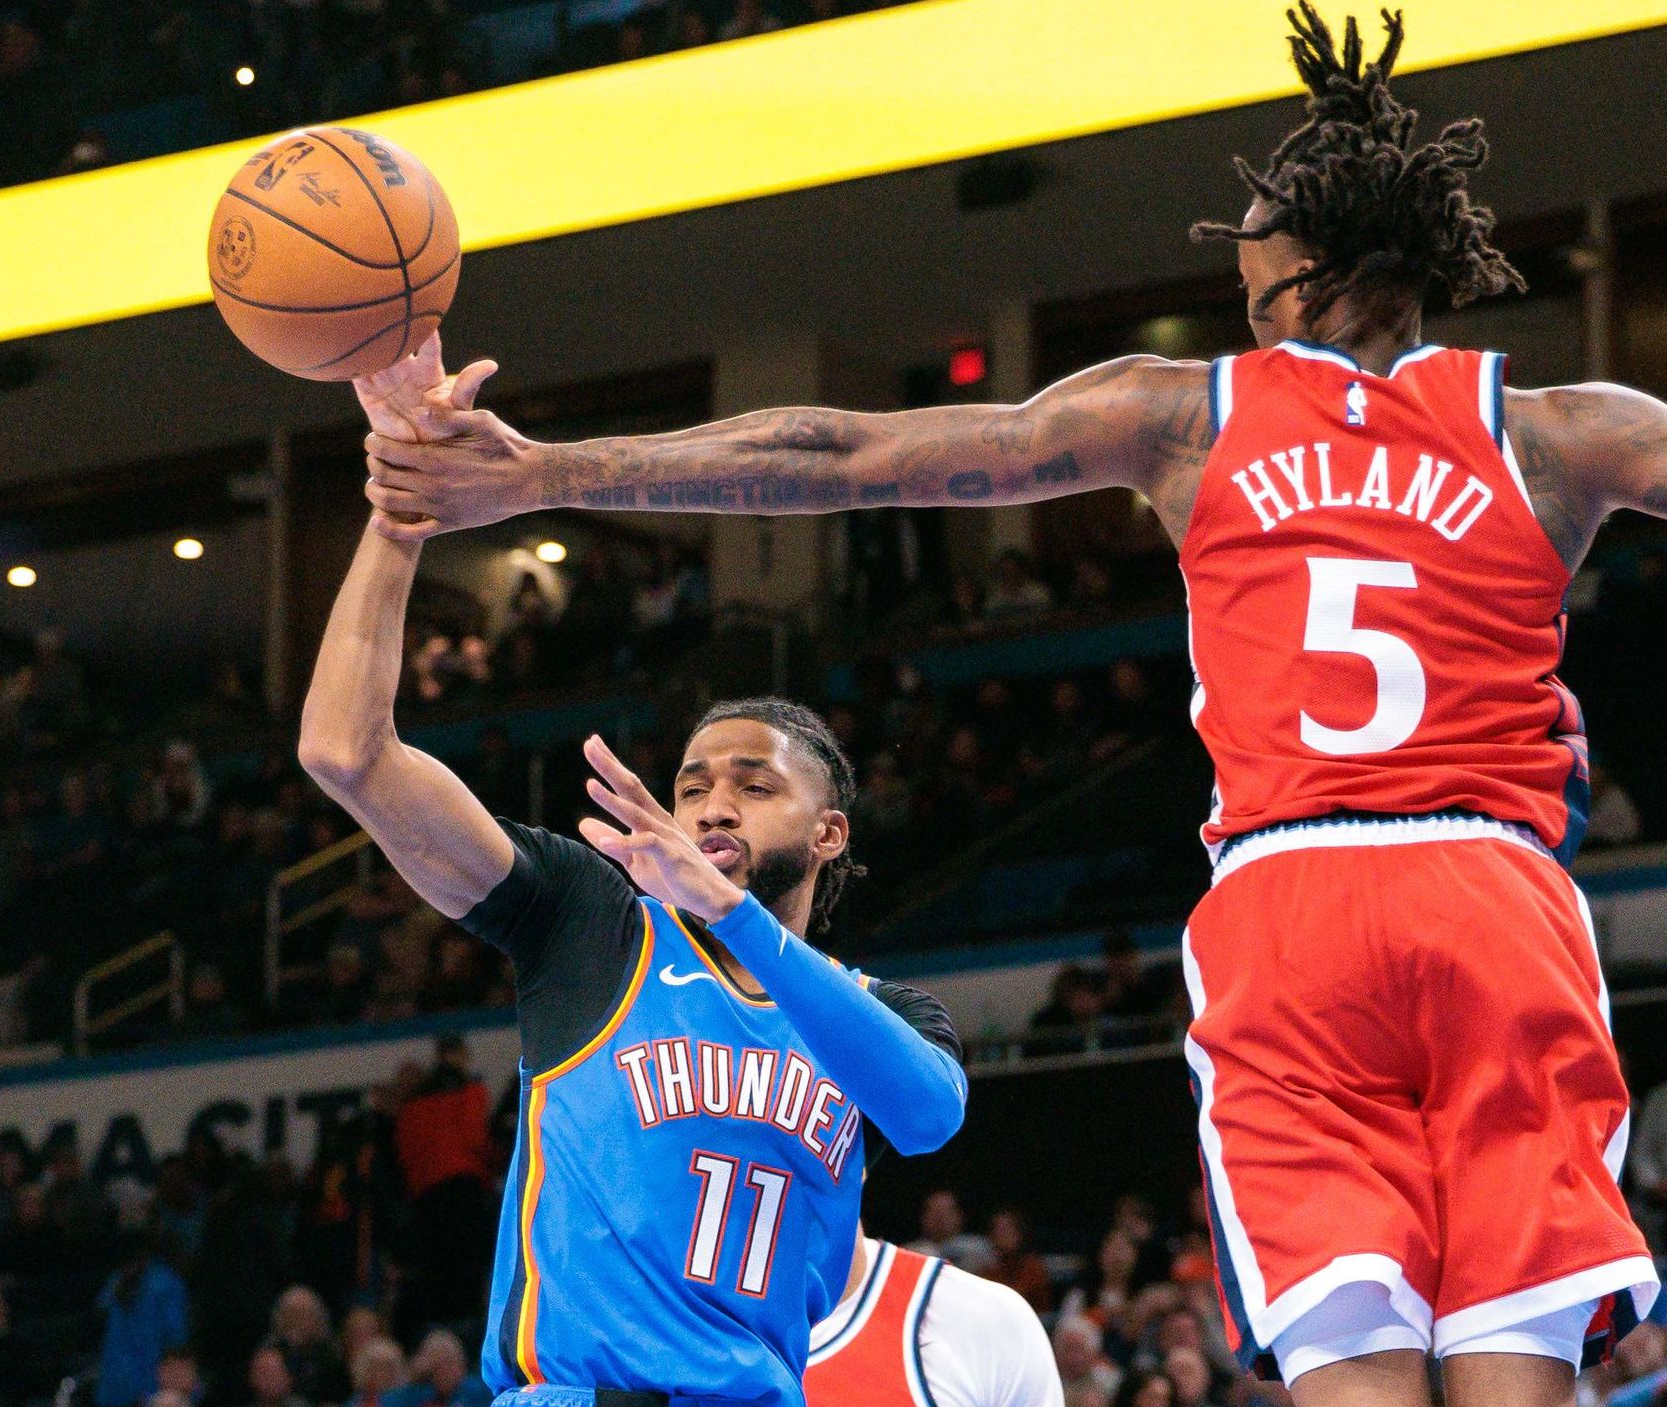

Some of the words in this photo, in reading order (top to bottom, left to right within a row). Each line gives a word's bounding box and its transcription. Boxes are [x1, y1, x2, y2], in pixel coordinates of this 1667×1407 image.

[1231, 441, 1494, 541] HYLAND
[1300, 556, 1427, 756] 5
[614, 1036, 862, 1186] THUNDER
[684, 1149, 793, 1300] 11
